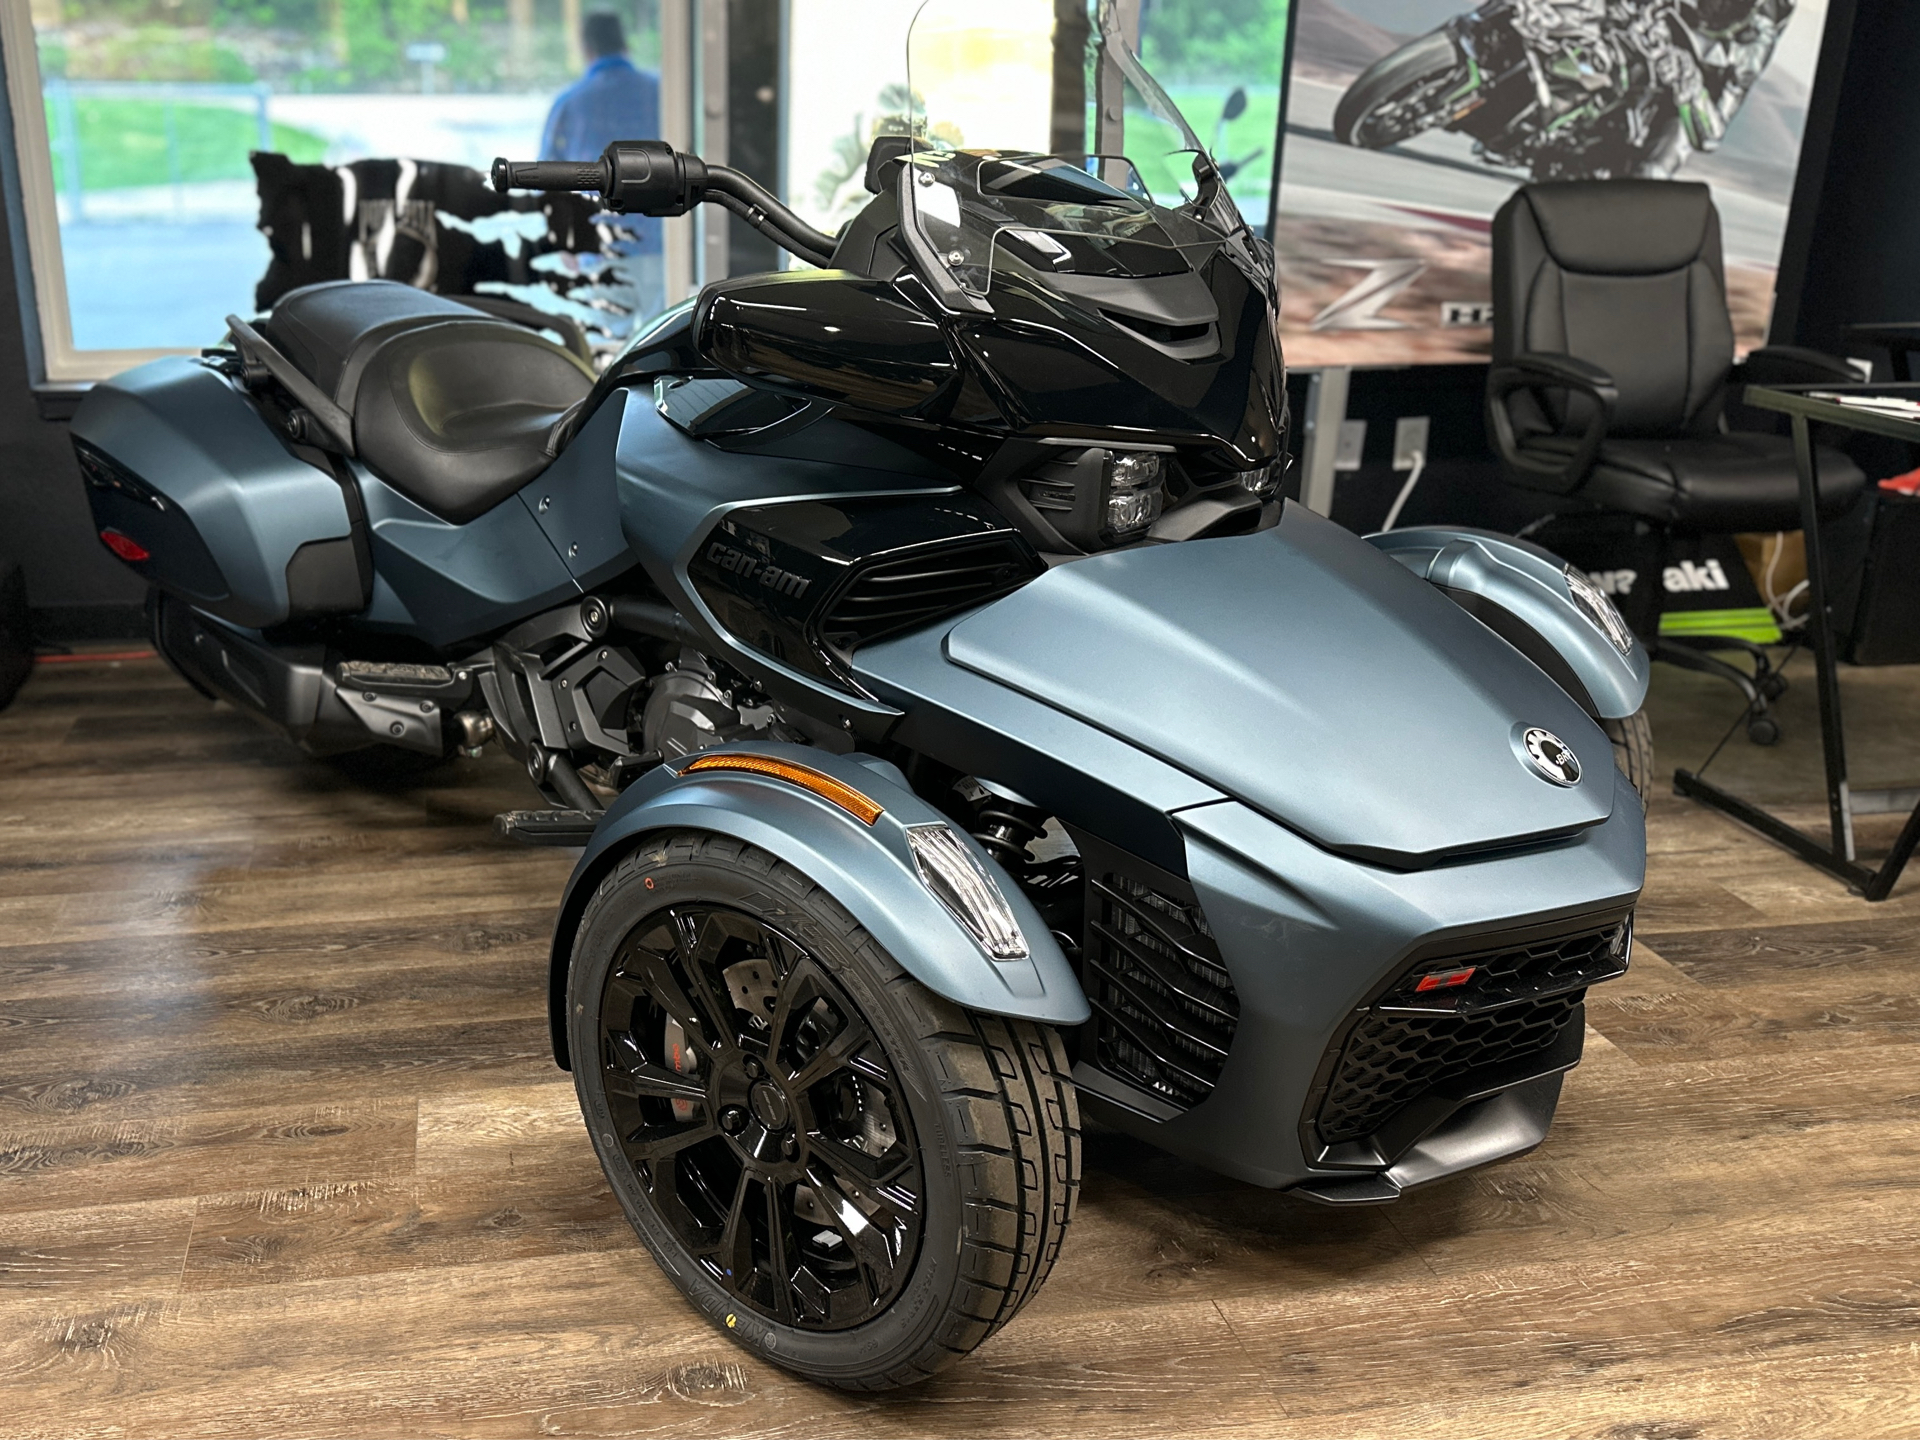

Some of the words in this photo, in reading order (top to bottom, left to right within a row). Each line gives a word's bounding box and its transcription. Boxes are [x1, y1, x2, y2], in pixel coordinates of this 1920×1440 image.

[706, 541, 812, 599] can-am
[933, 1123, 951, 1179] TUBELESS
[689, 1279, 767, 1347] KENDA
